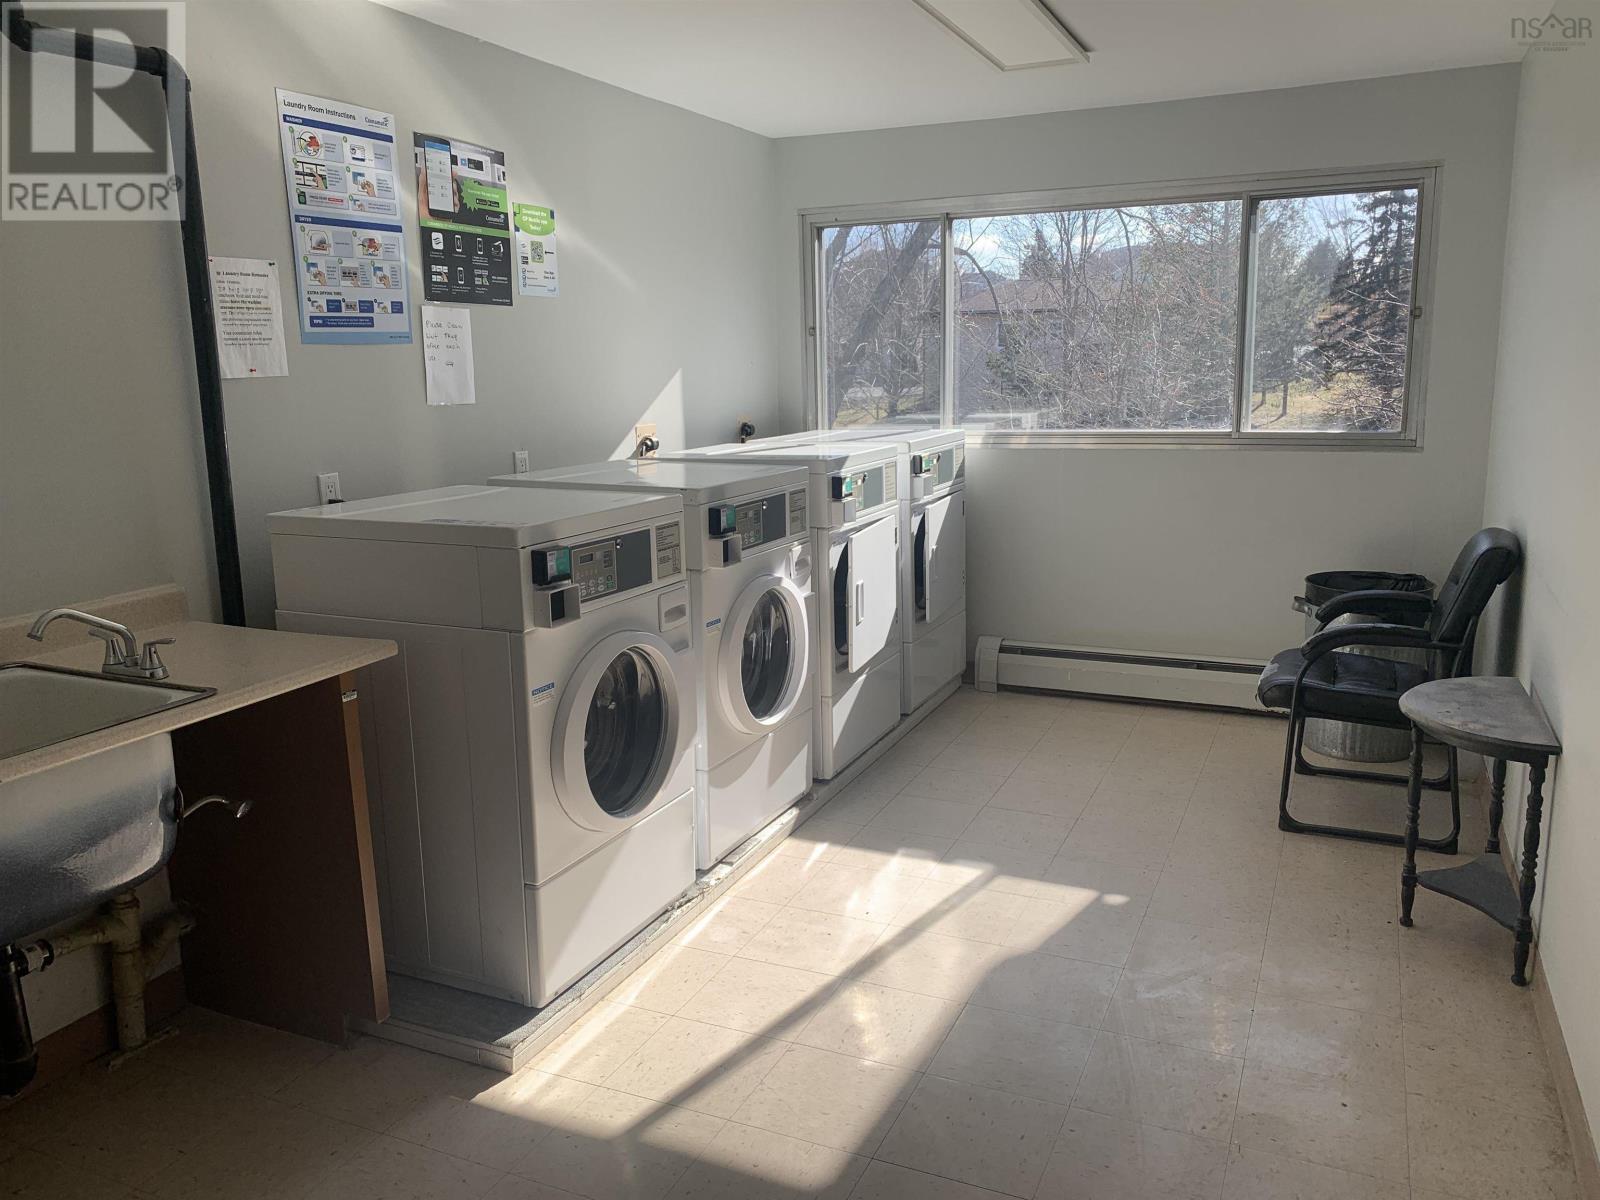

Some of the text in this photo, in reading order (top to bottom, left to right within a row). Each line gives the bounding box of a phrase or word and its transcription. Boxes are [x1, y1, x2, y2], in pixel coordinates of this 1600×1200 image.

[283, 99, 356, 120] Laundry Room Instructions
